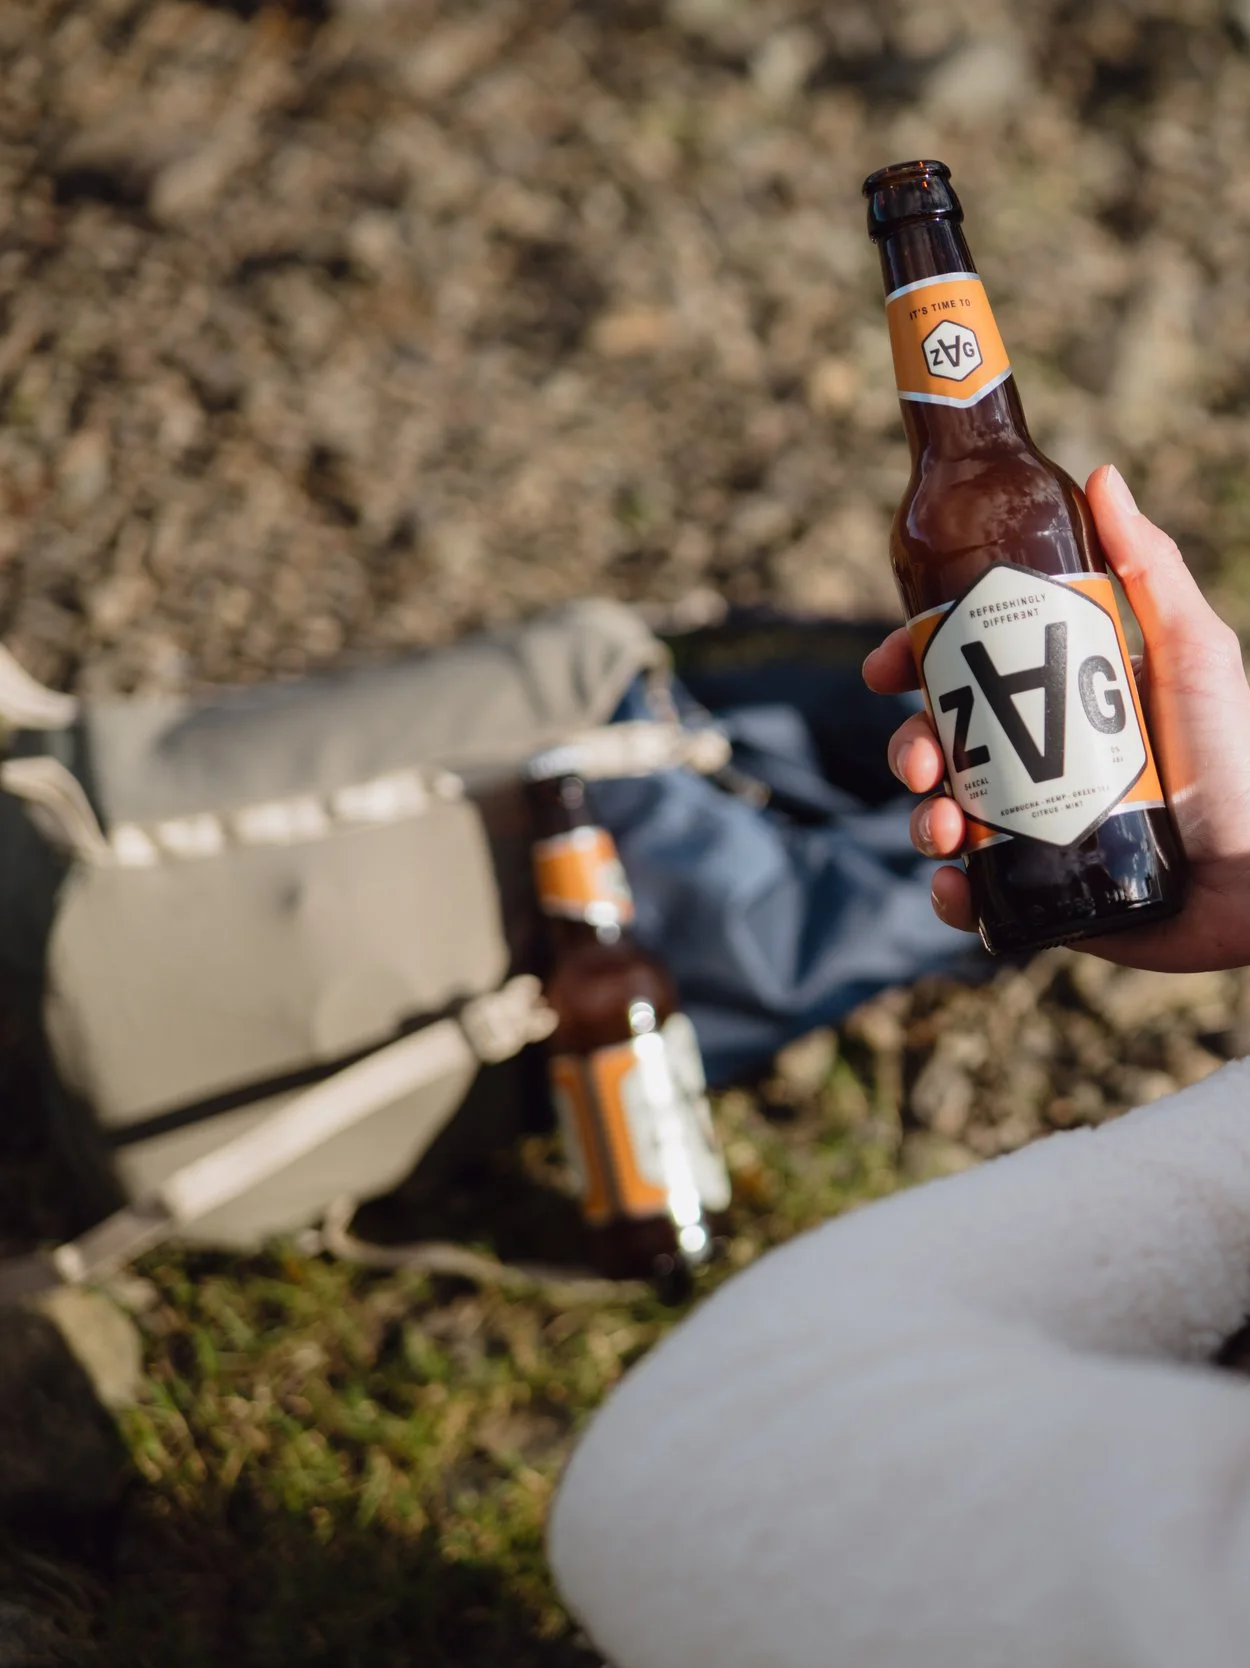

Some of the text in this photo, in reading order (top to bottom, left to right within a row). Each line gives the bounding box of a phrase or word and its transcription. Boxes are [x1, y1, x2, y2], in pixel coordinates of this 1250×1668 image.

[909, 298, 971, 320] IT'S TIME TO
[930, 335, 975, 368] ZAG
[969, 593, 1046, 618] REFRESHINGLY
[939, 621, 1127, 783] ZAG
[972, 777, 989, 788] KCAL
[1000, 801, 1039, 817] KOMBUCHA
[1045, 794, 1066, 805] HEMP
[1072, 788, 1096, 798] GREEN
[1031, 800, 1083, 818] CITRUS MINT
